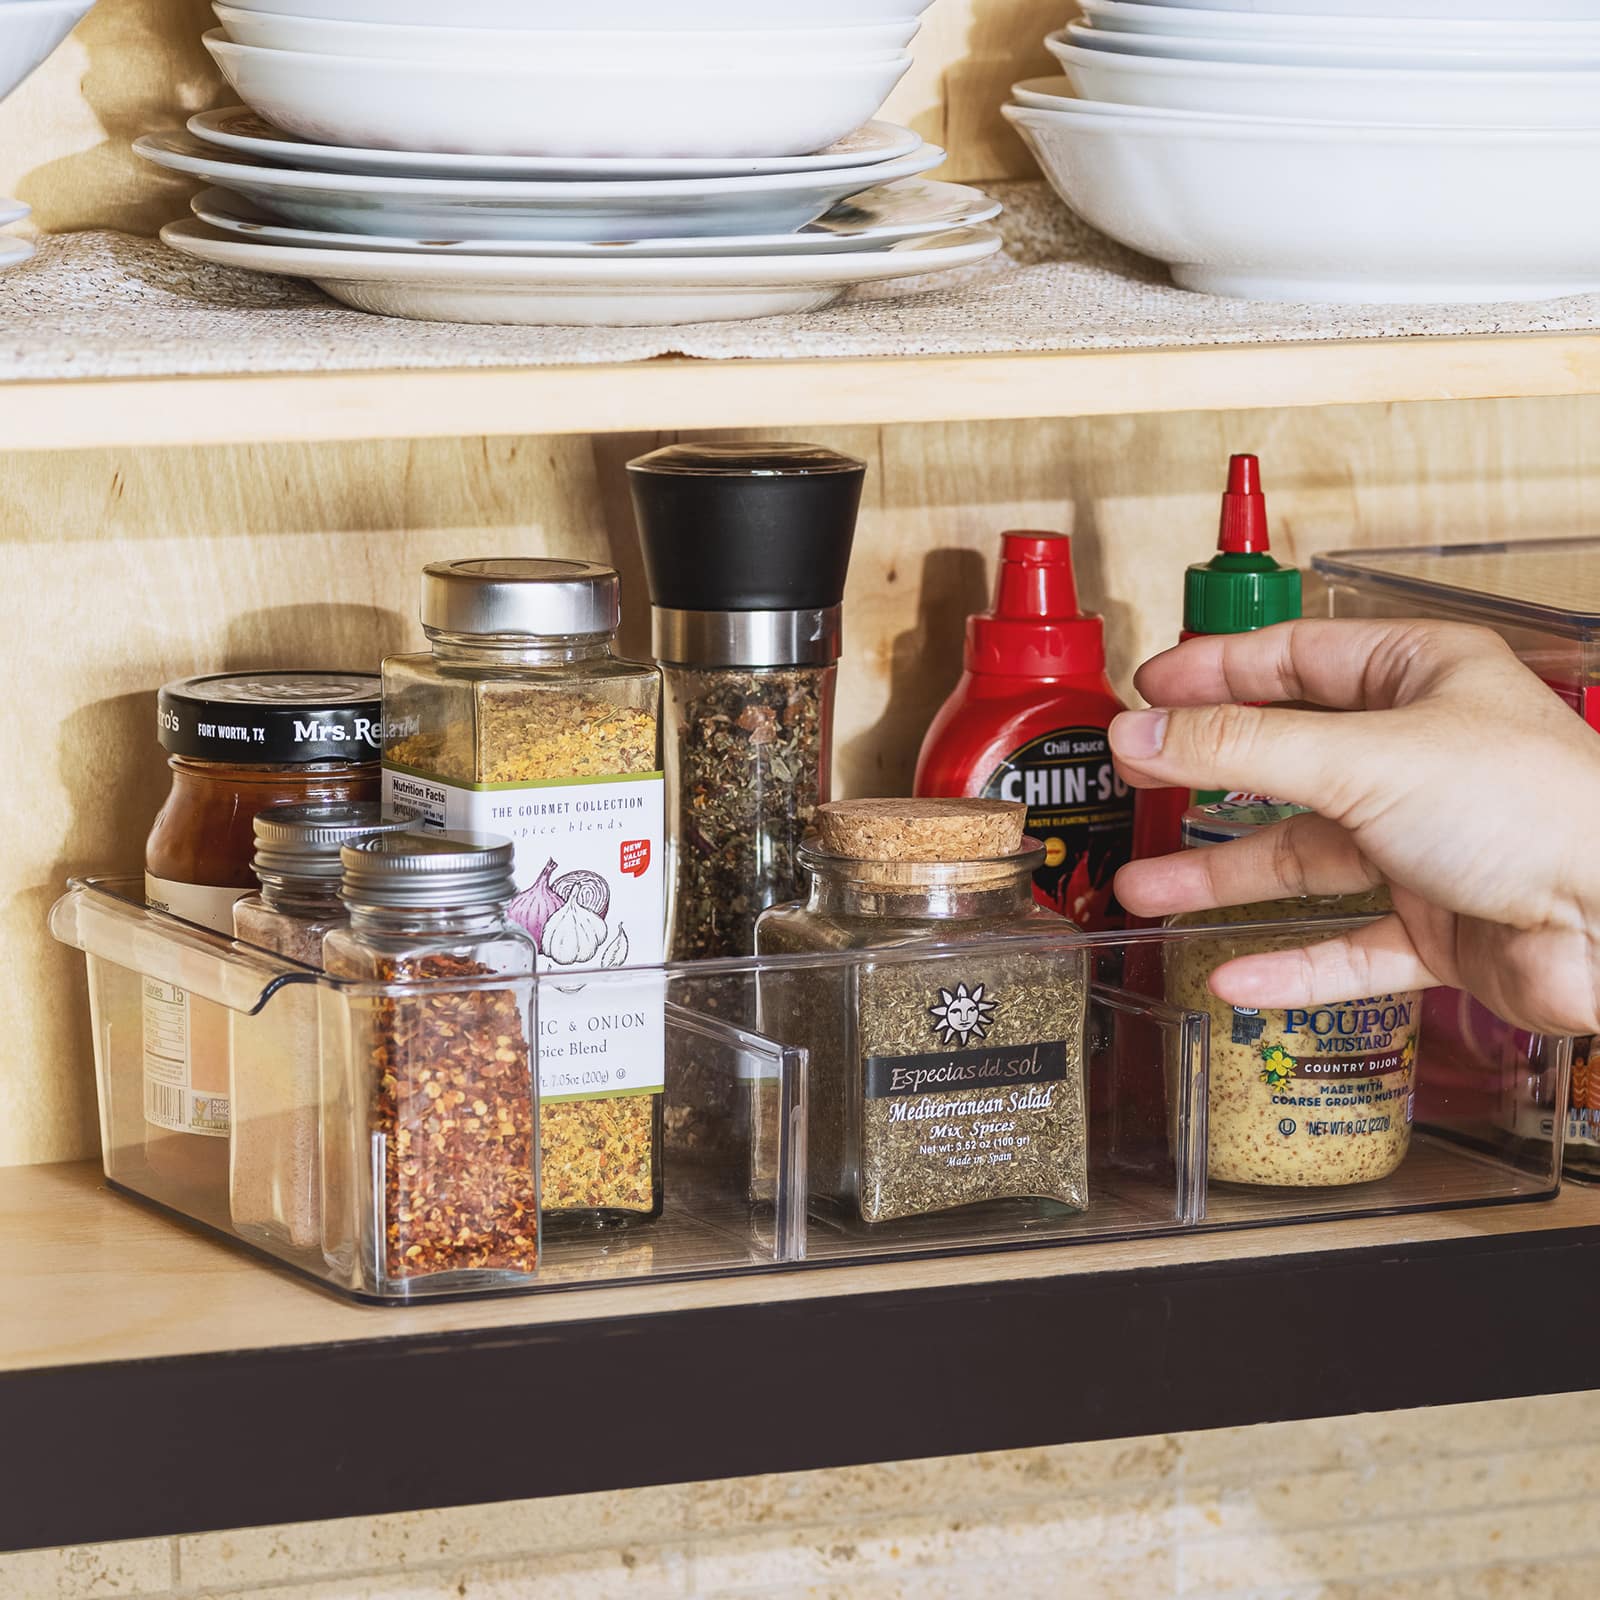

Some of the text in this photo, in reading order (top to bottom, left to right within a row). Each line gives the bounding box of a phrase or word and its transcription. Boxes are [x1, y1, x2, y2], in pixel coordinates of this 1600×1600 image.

[197, 722, 265, 742] FORT WORTH, TX
[293, 720, 351, 742] Mrs.
[1043, 740, 1104, 756] Chili sauce
[393, 779, 424, 798] Nutrition
[425, 788, 445, 803] Facts
[492, 797, 644, 819] THE GOURMET COLLECTION
[513, 818, 624, 837] spice blends
[623, 841, 642, 853] NEW
[623, 849, 647, 862] VALUE
[623, 858, 641, 869] SIZE
[171, 984, 184, 1003] 15
[568, 1021, 577, 1032] &
[587, 1012, 646, 1032] ONION
[1282, 1002, 1413, 1035] POUPON
[569, 1039, 607, 1056] Blend
[1317, 1033, 1392, 1053] MUSTARD
[890, 1047, 1042, 1092] Especias del sol
[1304, 1057, 1398, 1073] COUNTRY DIJON
[551, 1072, 580, 1087] 7.05oz
[582, 1069, 609, 1086] (200g)
[1320, 1080, 1383, 1095] MADE WITH
[888, 1086, 1055, 1123] Mediterranean Salad
[1272, 1095, 1321, 1107] COARSE
[1325, 1094, 1372, 1107] GROUND
[930, 1119, 1016, 1139] Mix Spices
[1308, 1121, 1329, 1136] NET
[1330, 1121, 1347, 1135] WT
[1347, 1121, 1354, 1134] 8
[1355, 1119, 1368, 1133] OZ
[1369, 1116, 1391, 1132] (227g)
[919, 1144, 936, 1154] Net
[979, 1141, 991, 1149] oz
[993, 1136, 1013, 1149] (100
[1016, 1134, 1030, 1147] gr)
[946, 1152, 1012, 1167] Made in Spain
